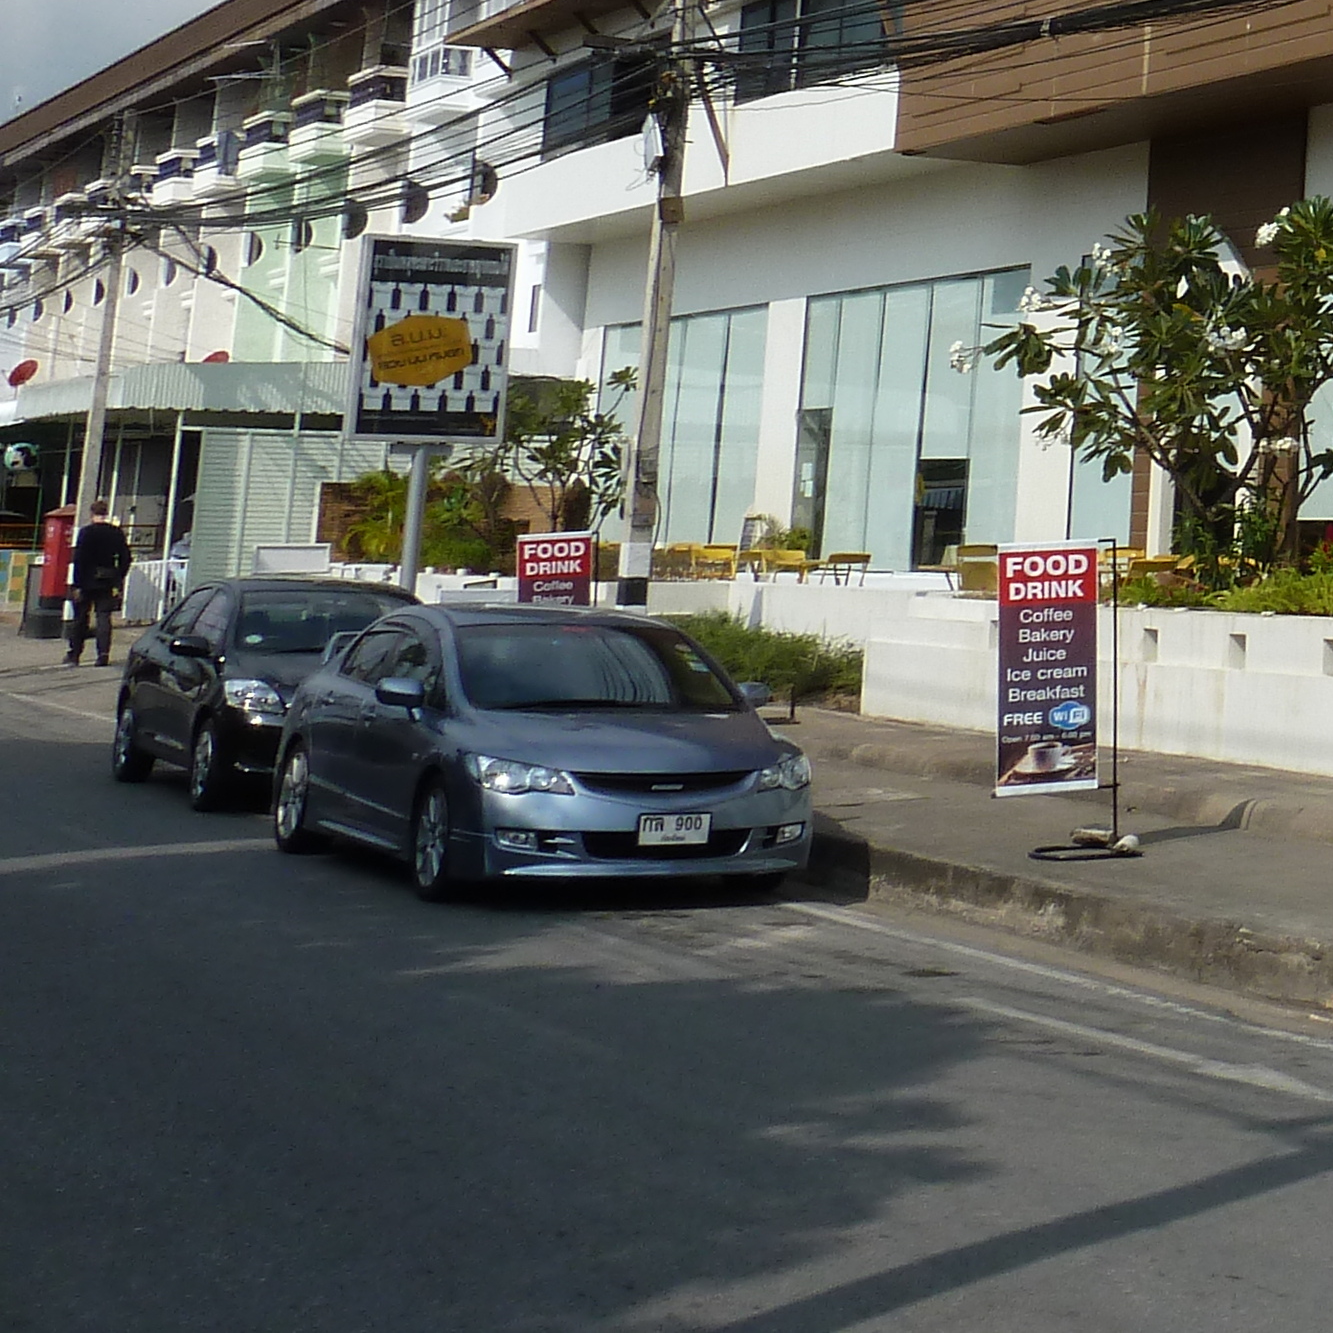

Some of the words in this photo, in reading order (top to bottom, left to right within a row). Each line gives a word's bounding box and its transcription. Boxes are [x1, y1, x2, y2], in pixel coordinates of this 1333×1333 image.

[523, 541, 586, 560] FOOD
[525, 560, 582, 576] DRINK
[1006, 554, 1089, 578] FOOD
[533, 580, 574, 592] Coffee
[1009, 580, 1084, 601] DRINK
[1020, 608, 1073, 624] Coffee
[1018, 628, 1074, 644] Bakery
[1023, 648, 1067, 662] Juice
[1007, 667, 1031, 682] Ice
[1037, 665, 1088, 680] cream
[1008, 684, 1086, 702] Breakfast
[1003, 711, 1043, 727] FREE
[675, 816, 703, 831] 900
